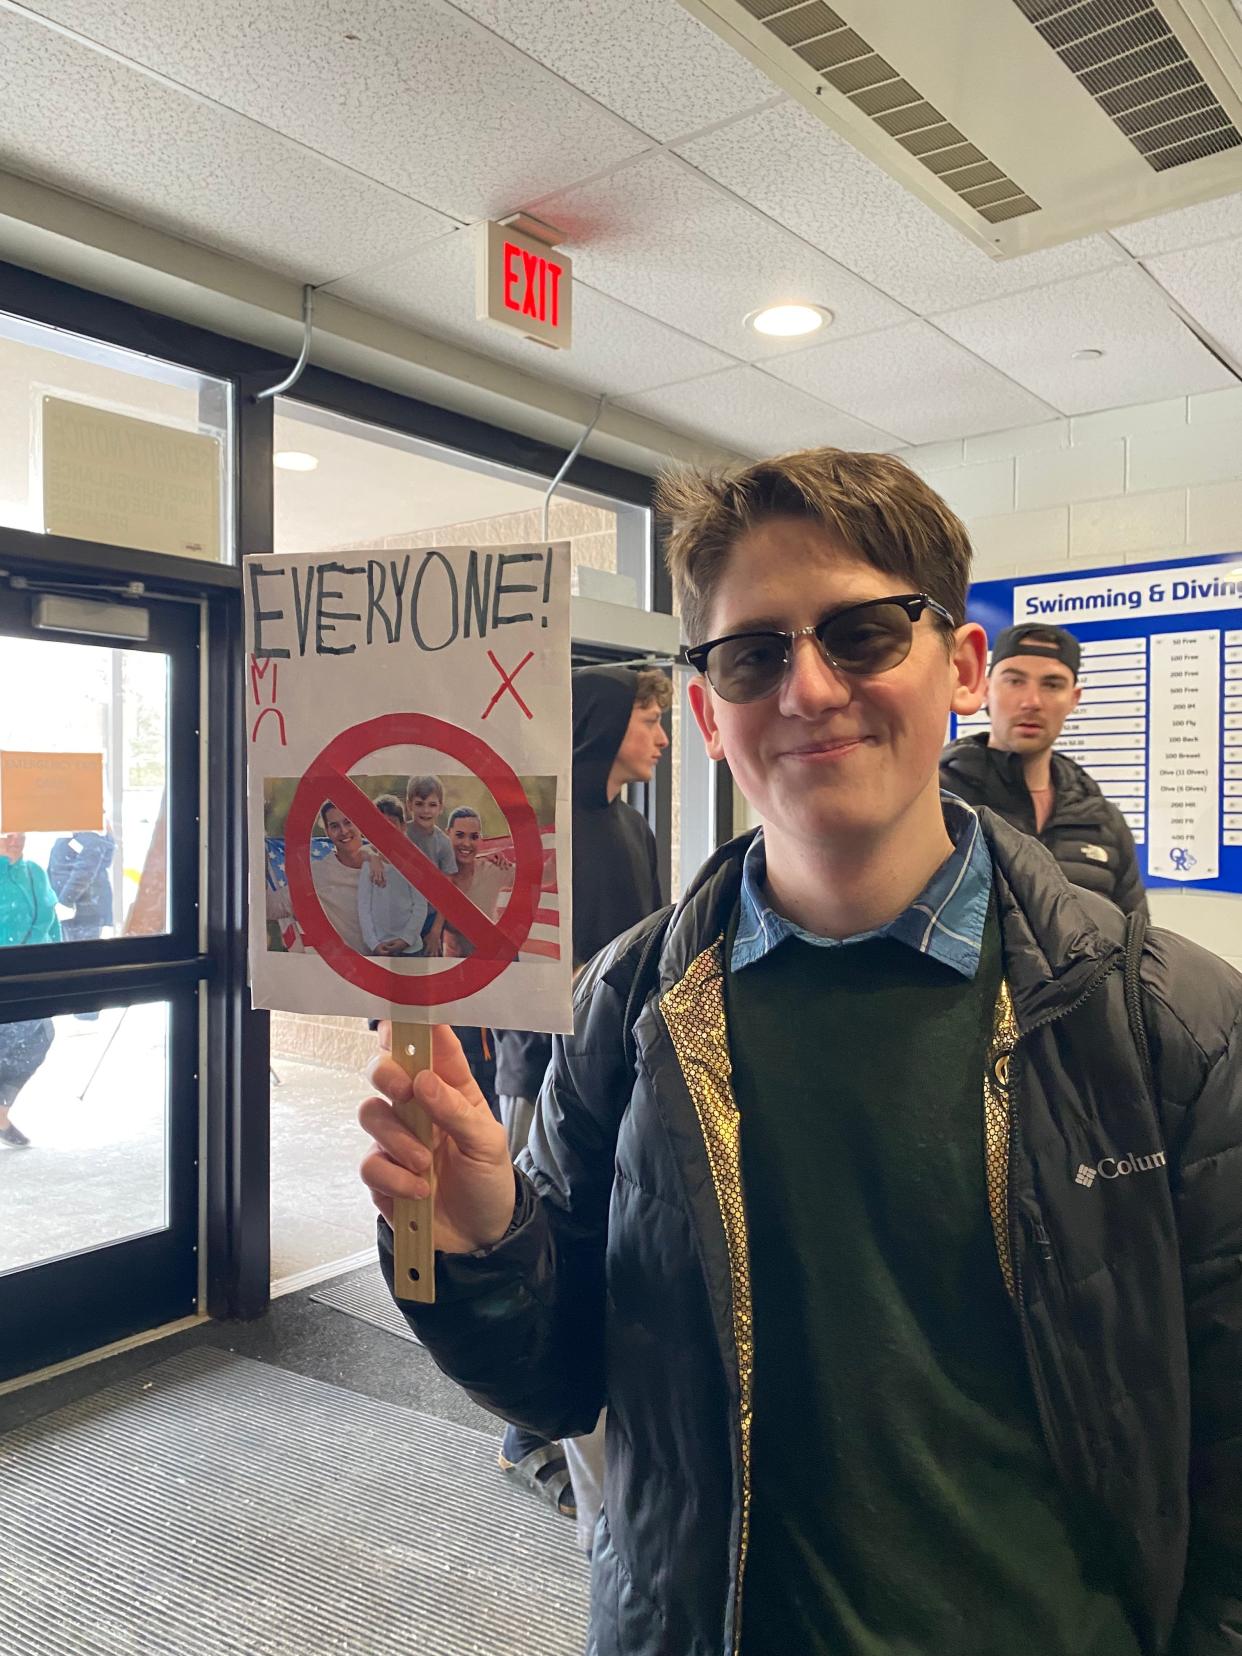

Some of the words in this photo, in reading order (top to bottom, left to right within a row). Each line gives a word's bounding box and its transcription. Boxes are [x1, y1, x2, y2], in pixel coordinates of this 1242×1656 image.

[504, 241, 562, 328] EXIT
[249, 547, 552, 659] EVERYONE!
[1025, 588, 1142, 615] Swimming
[1149, 583, 1165, 602] &
